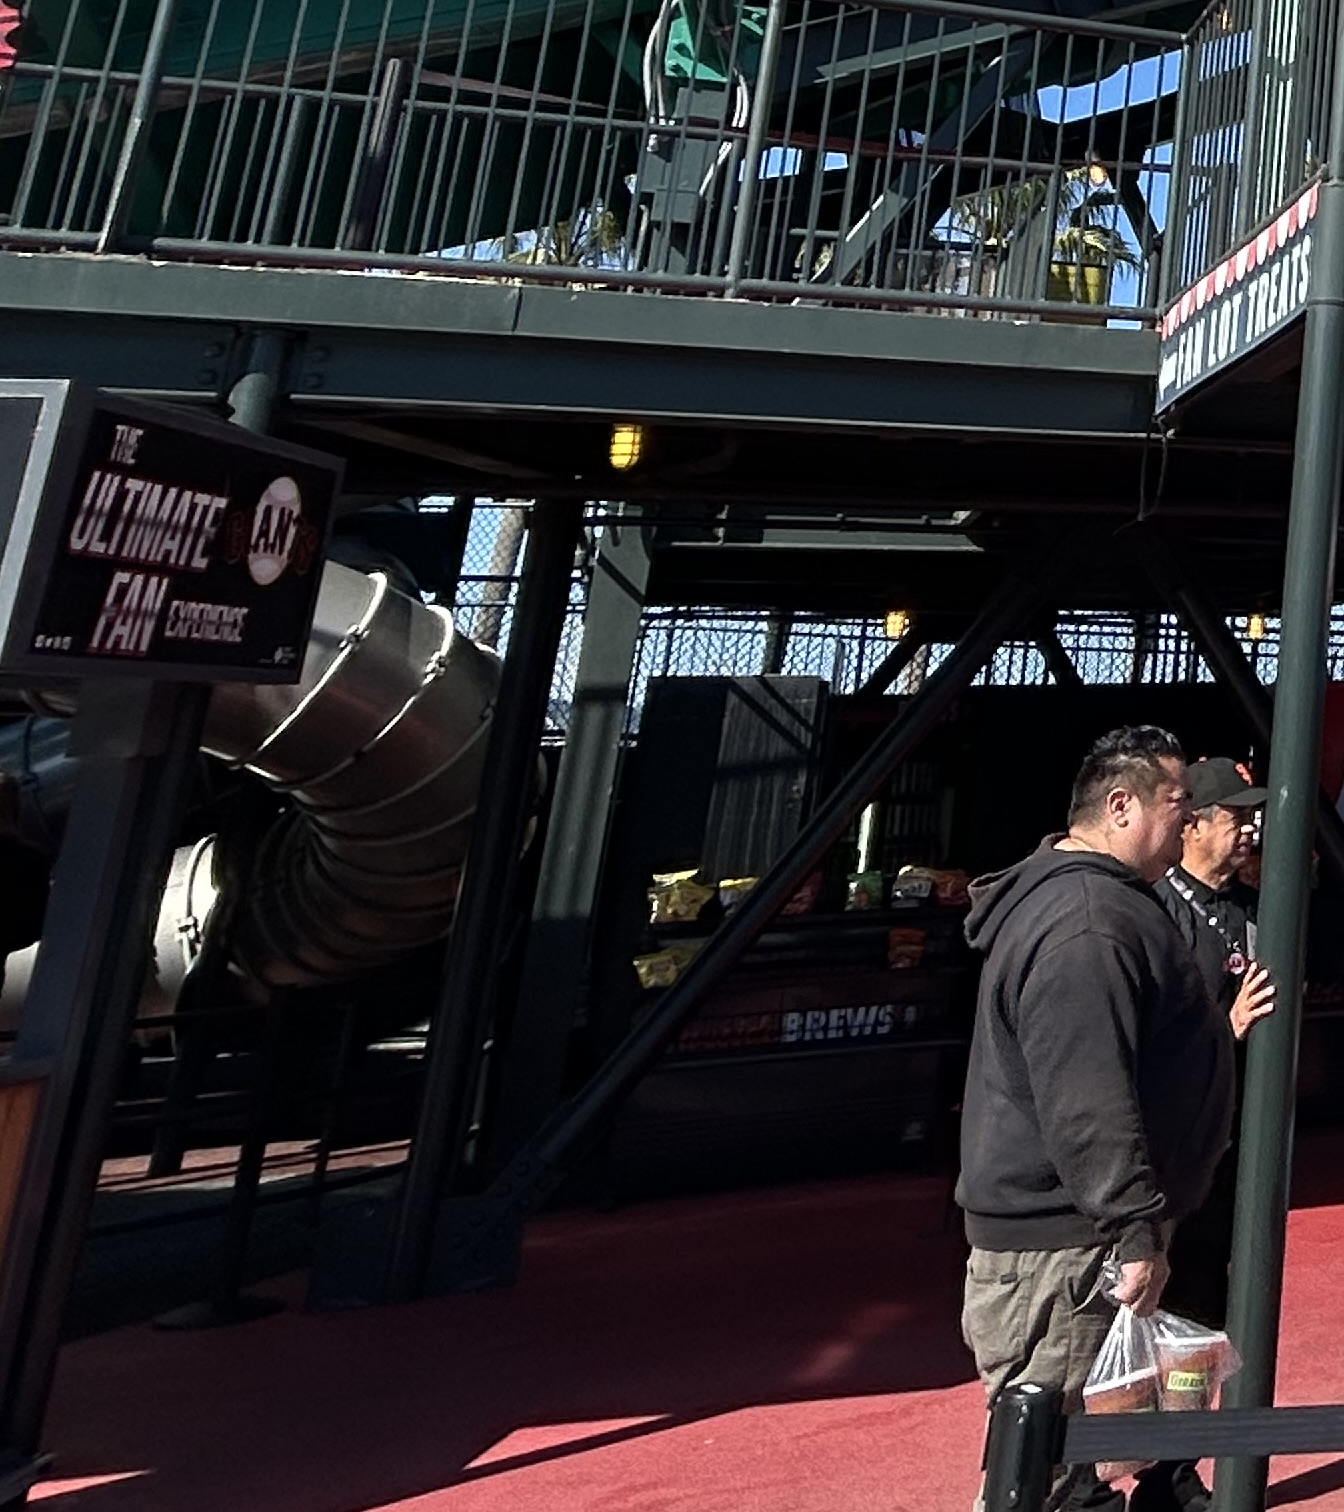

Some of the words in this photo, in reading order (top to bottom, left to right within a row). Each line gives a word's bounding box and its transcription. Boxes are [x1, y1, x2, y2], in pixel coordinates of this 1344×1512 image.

[1176, 316, 1206, 389] FAN
[1207, 291, 1243, 368] LOT
[1245, 233, 1313, 344] TREATS
[108, 424, 145, 466] THE
[68, 469, 230, 572] ULTIMATE
[86, 569, 171, 655] FAN
[782, 1004, 894, 1043] BREWS
